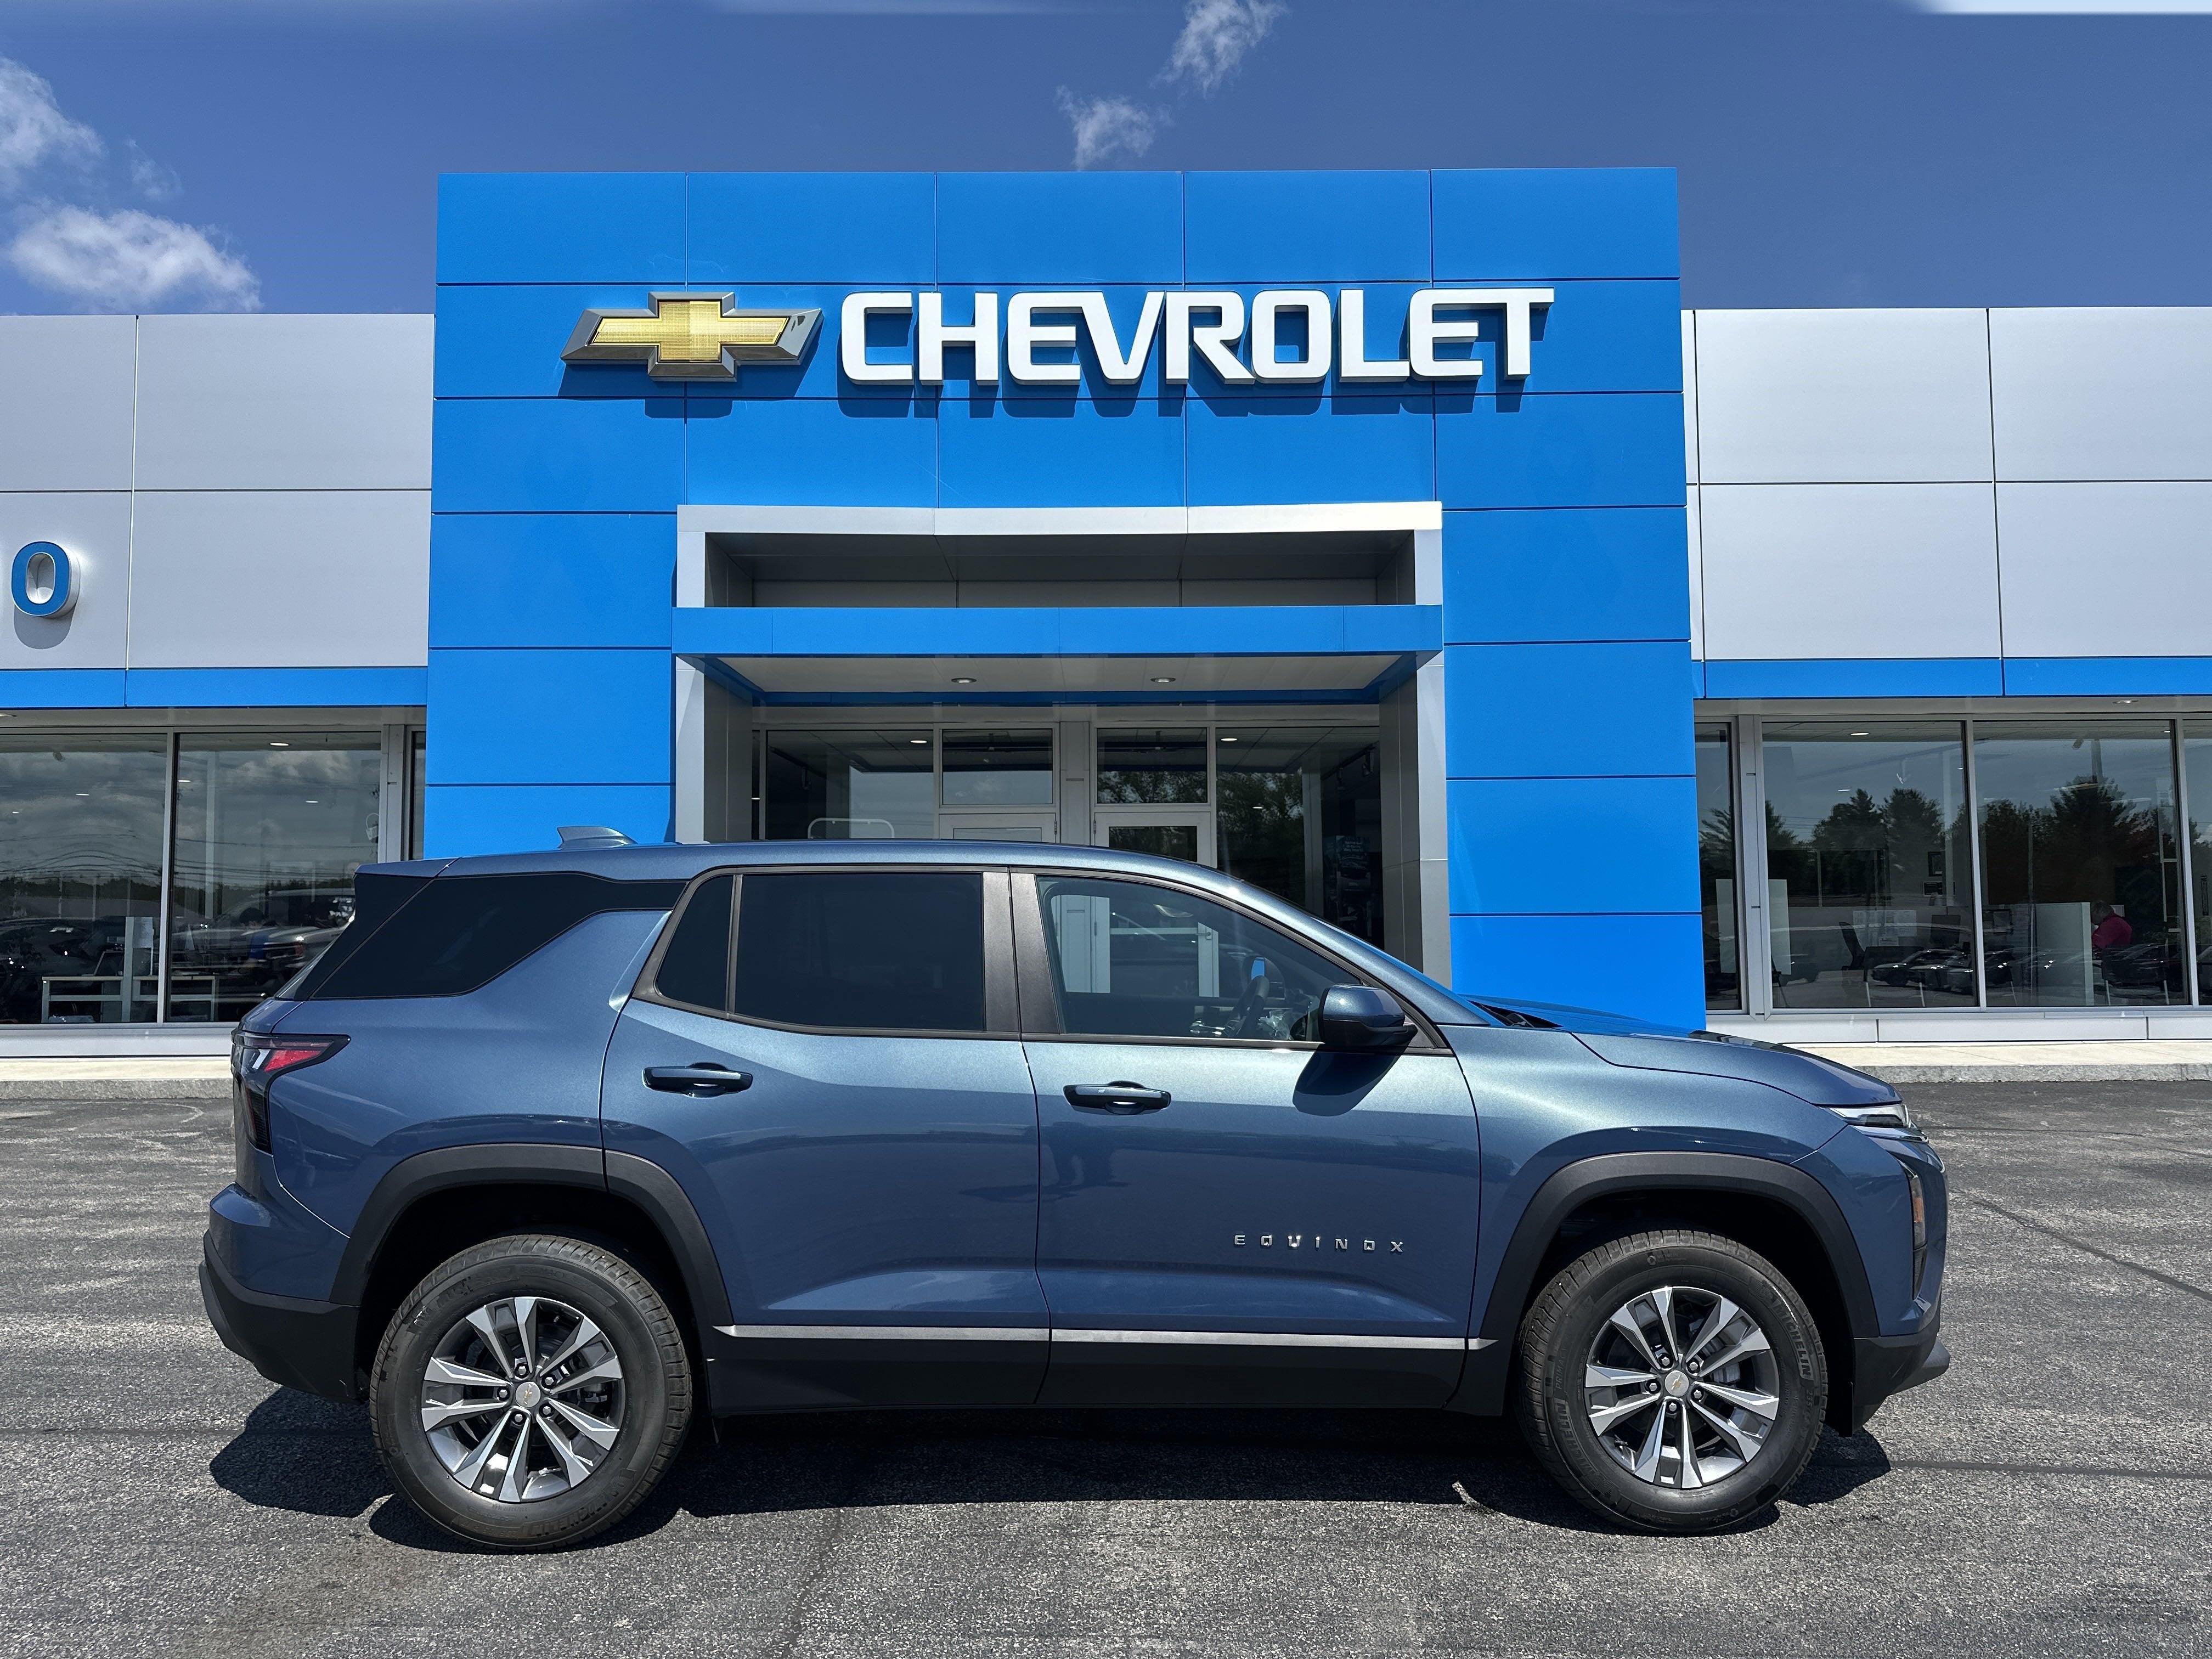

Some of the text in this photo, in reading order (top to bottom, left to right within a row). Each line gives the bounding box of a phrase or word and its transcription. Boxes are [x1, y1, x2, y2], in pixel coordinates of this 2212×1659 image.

[841, 287, 1554, 385] CHEVROLET
[12, 541, 77, 618] O
[1234, 1234, 1403, 1253] EQUINOX
[1773, 1301, 1812, 1376] MICHELIN
[1556, 1402, 1595, 1476] MICHELIN
